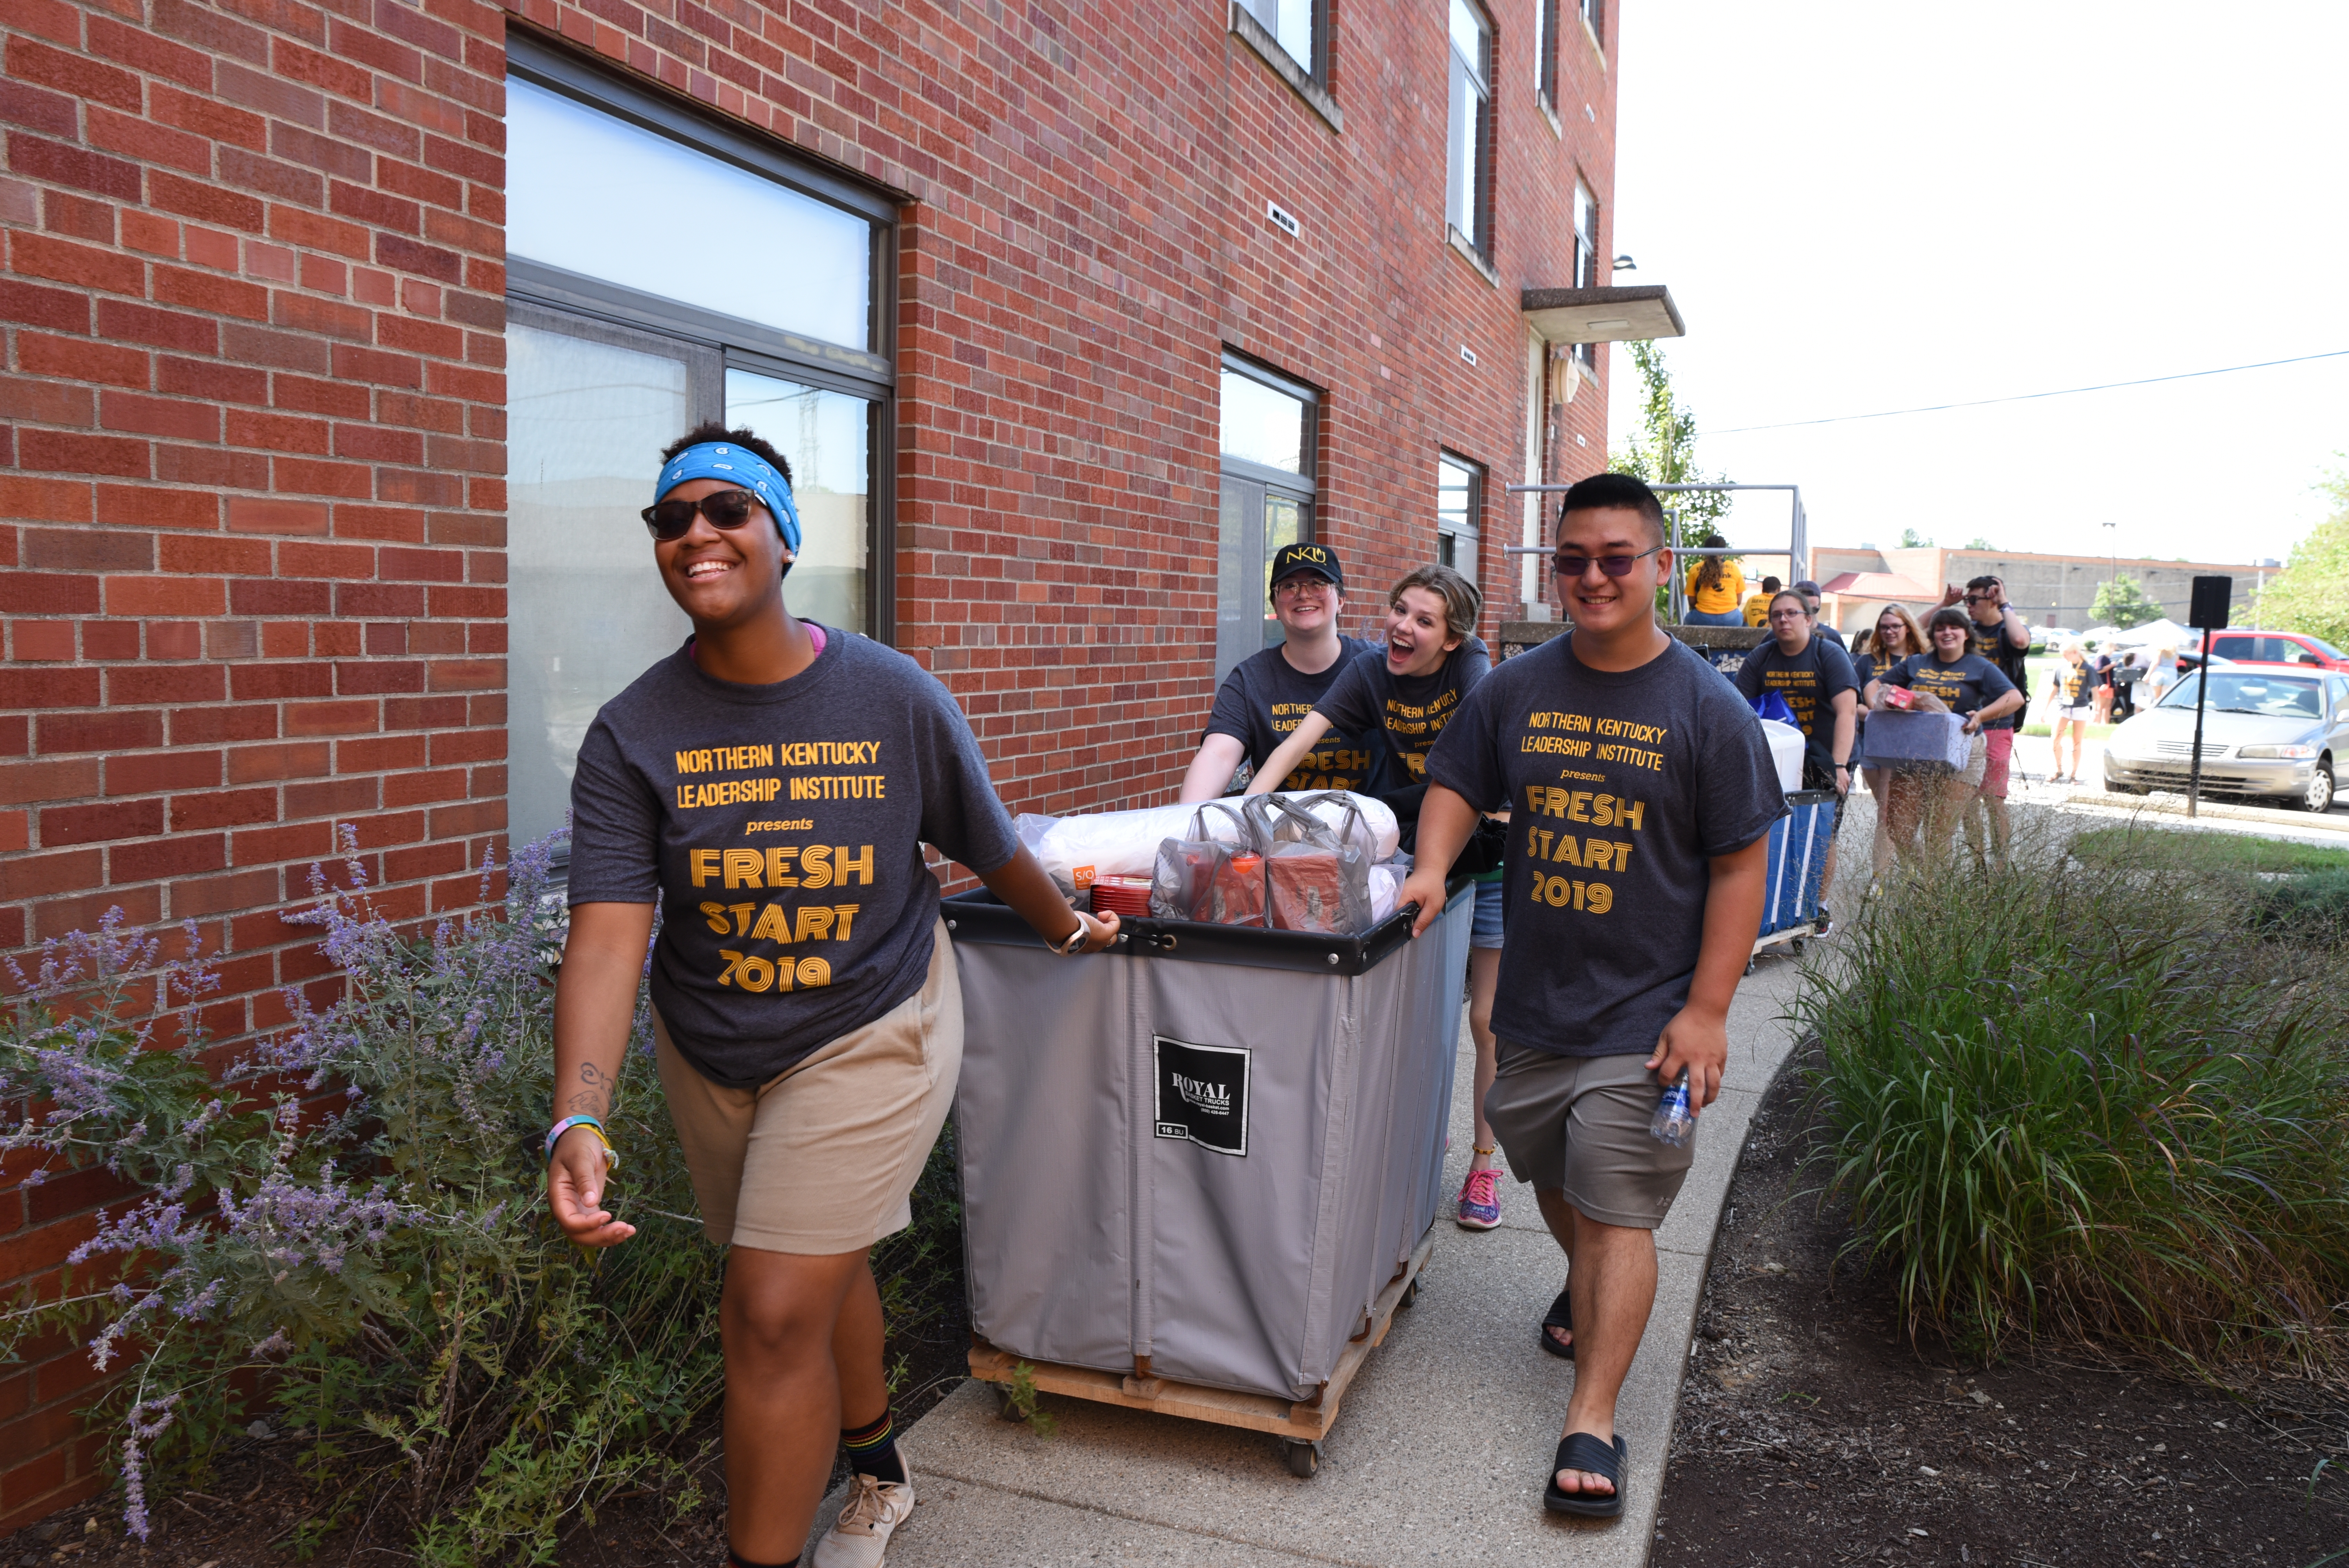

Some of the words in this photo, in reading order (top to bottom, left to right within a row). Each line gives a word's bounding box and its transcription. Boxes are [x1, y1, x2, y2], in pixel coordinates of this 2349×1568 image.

[1286, 547, 1326, 564] NKU
[1272, 703, 1314, 715] NORTHER
[1529, 712, 1592, 732] NORTHERN
[1596, 718, 1666, 745] KENTUCKY
[676, 744, 773, 774] NORTHERN
[781, 741, 881, 766] KENTUCKY
[1298, 750, 1371, 771] RESH
[1521, 736, 1592, 757] LEADERSHIP
[1596, 743, 1663, 771] INSTITUTE
[677, 778, 781, 808] LEADERSHIP
[790, 775, 885, 800] INSTITUTE
[1560, 769, 1605, 782] presents
[1526, 786, 1644, 830] FRESH
[745, 818, 813, 835] presents
[1527, 826, 1633, 872] START
[690, 845, 873, 889] FRESH
[1531, 871, 1613, 914] 2019
[700, 902, 860, 944] START
[717, 949, 831, 992] 2019
[1171, 1072, 1230, 1103] ROYAL
[1185, 1090, 1203, 1102] BASKET
[1204, 1098, 1230, 1106] TRUCKS
